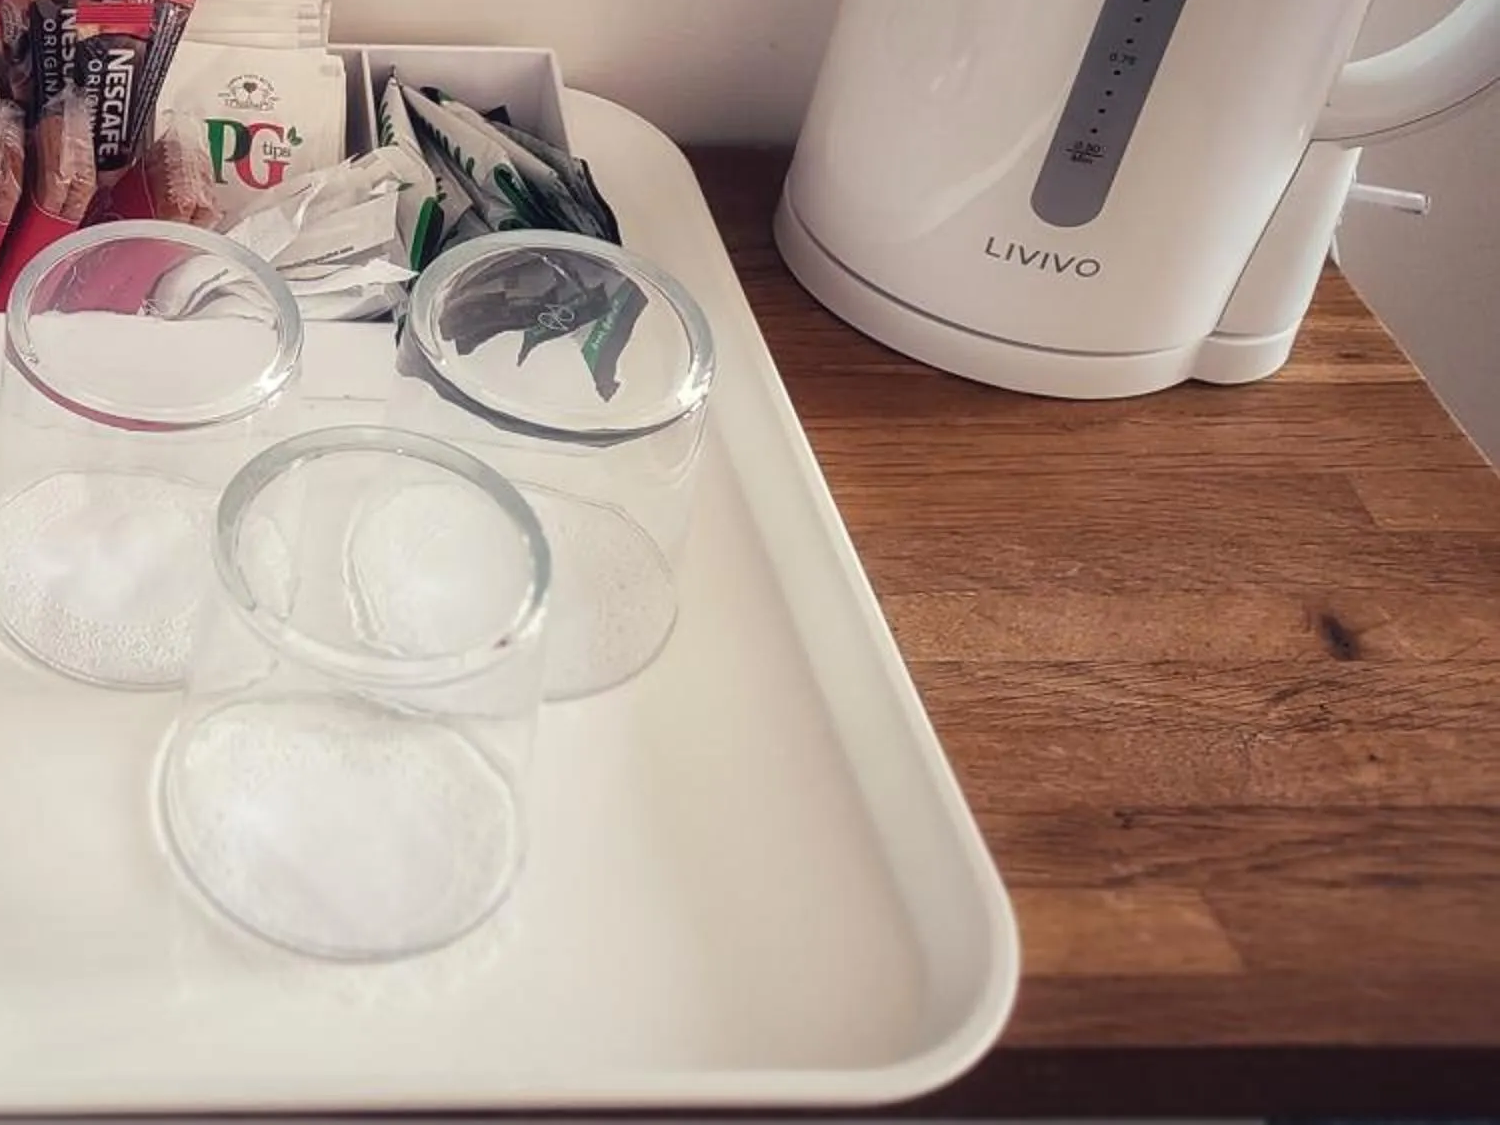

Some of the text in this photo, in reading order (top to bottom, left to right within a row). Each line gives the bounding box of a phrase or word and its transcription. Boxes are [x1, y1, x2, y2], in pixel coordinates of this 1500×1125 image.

[203, 118, 291, 190] PG
[262, 140, 292, 160] tips
[985, 236, 1101, 278] LIVIVO
